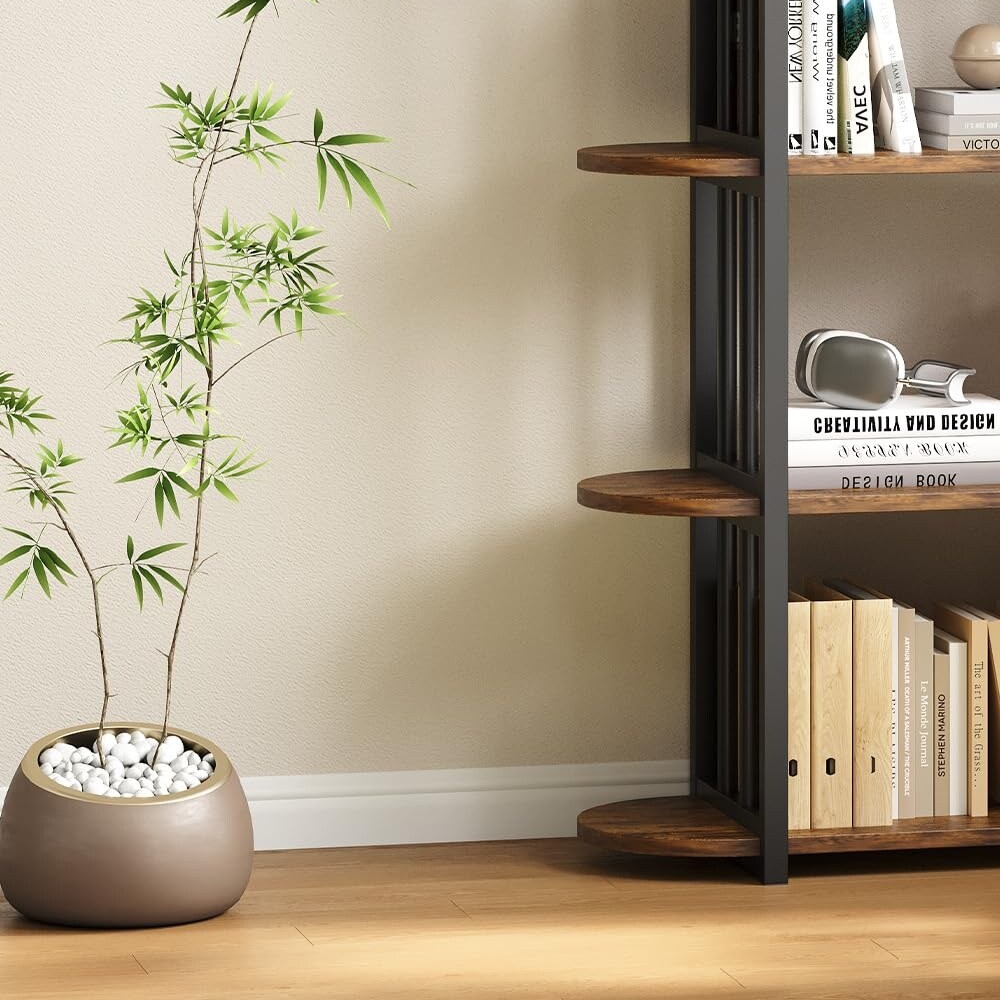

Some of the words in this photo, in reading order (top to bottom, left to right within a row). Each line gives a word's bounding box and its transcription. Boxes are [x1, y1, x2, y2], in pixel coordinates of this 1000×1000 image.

[974, 661, 984, 678] The
[920, 680, 929, 692] Le
[974, 684, 982, 700] art
[920, 695, 929, 729] Monde
[937, 693, 946, 731] MARINO
[974, 706, 984, 717] of
[974, 723, 984, 739] the
[919, 731, 929, 767] Journal
[937, 734, 946, 777] STEPHEN
